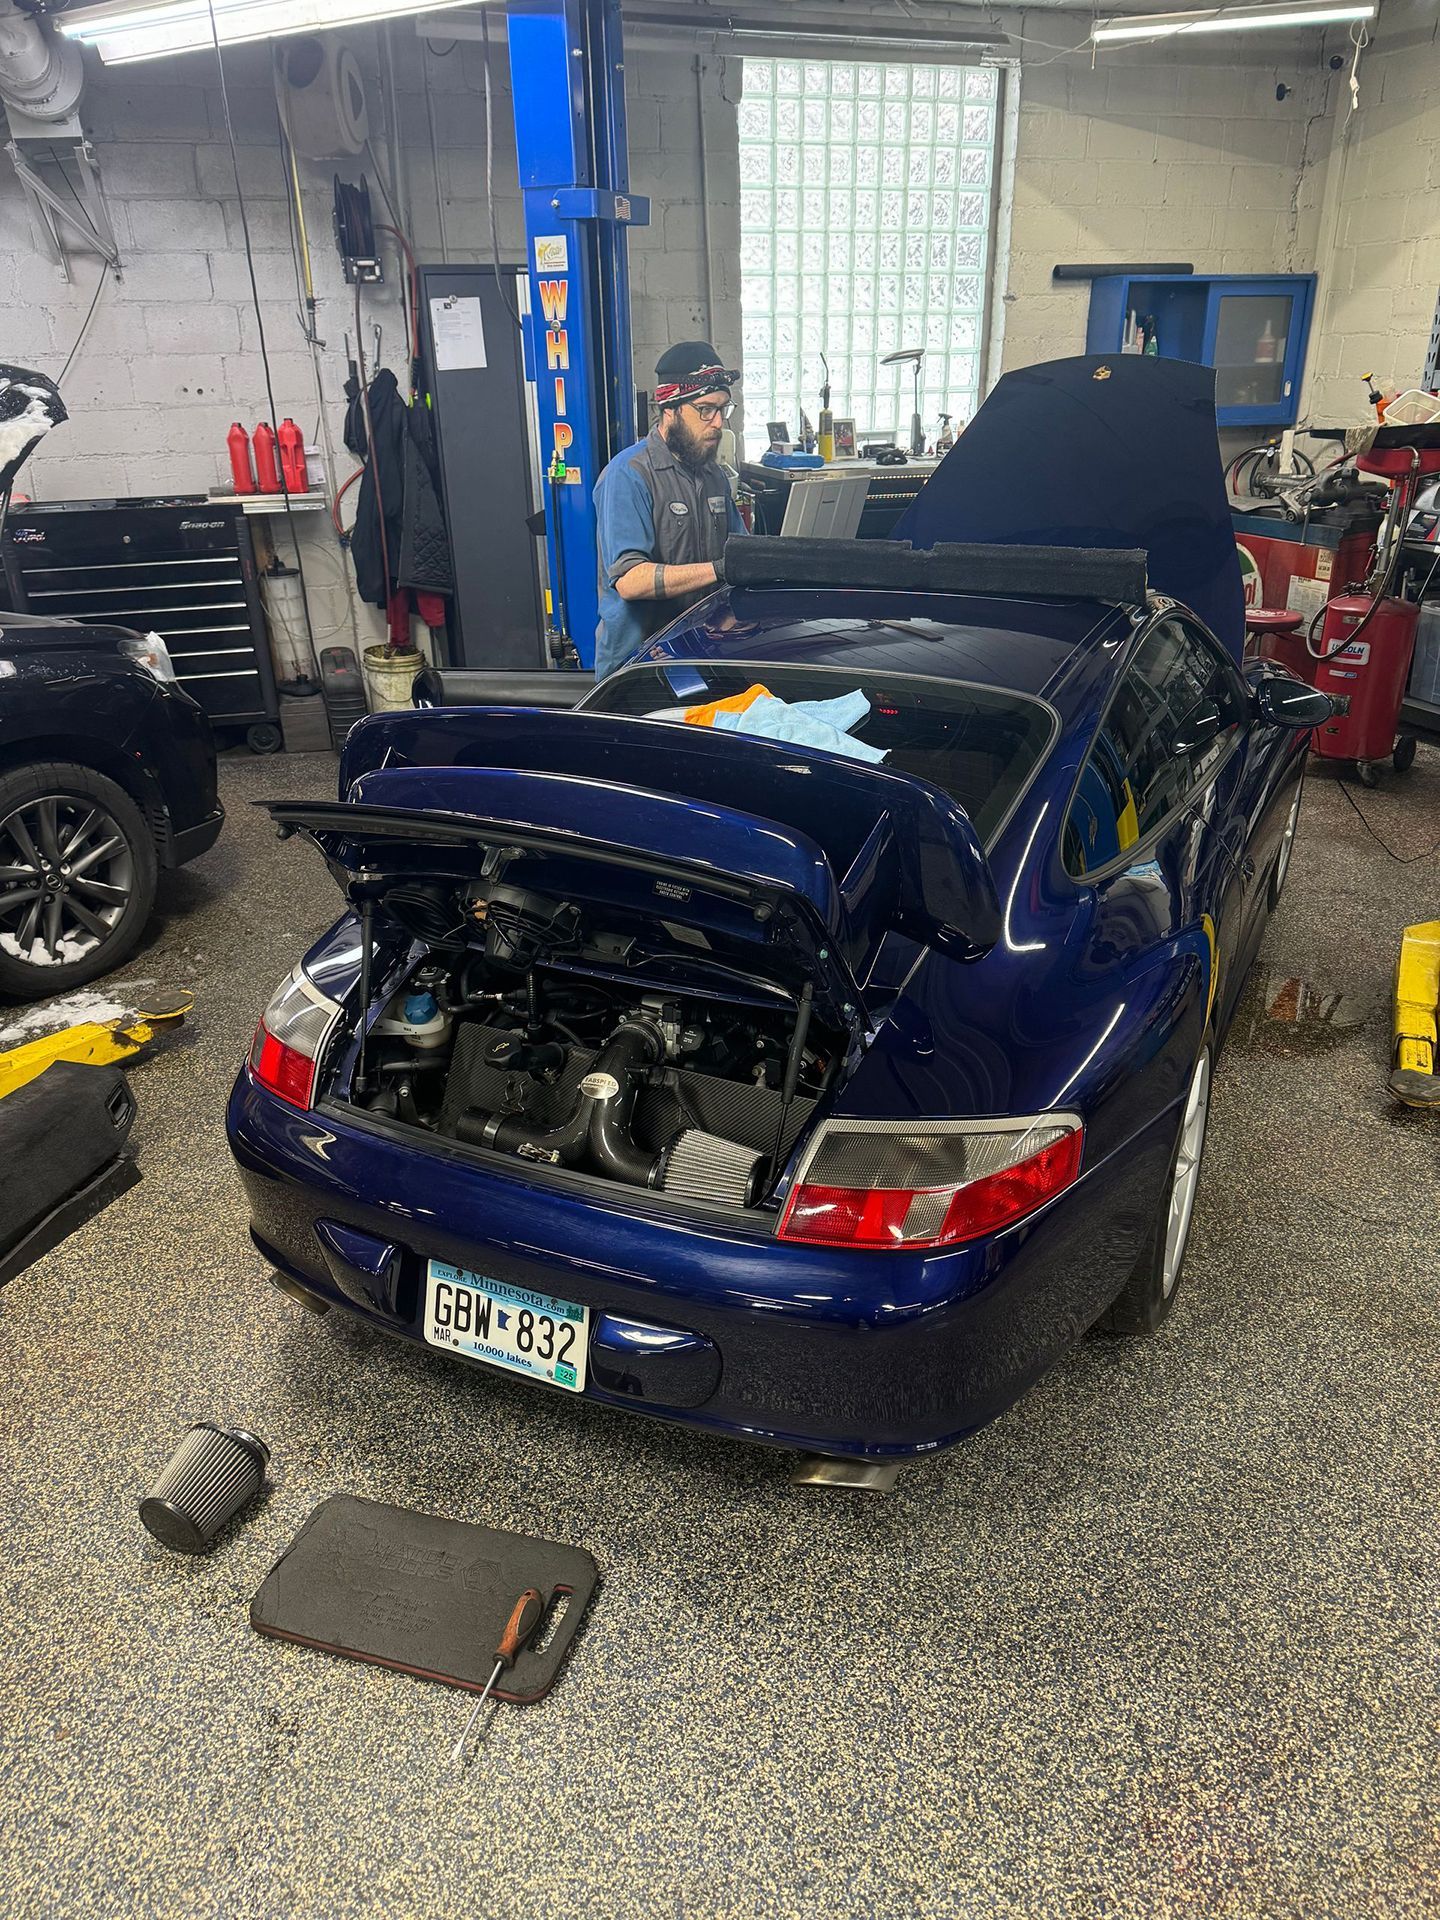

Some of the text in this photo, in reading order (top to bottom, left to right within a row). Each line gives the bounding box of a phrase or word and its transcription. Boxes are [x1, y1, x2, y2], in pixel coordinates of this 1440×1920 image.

[1331, 643, 1365, 655] LIOLN
[437, 1269, 468, 1283] EXPLORE
[434, 1283, 576, 1368] GBW 832
[433, 1326, 451, 1342] MAR
[473, 1341, 533, 1368] 10,000 lakes
